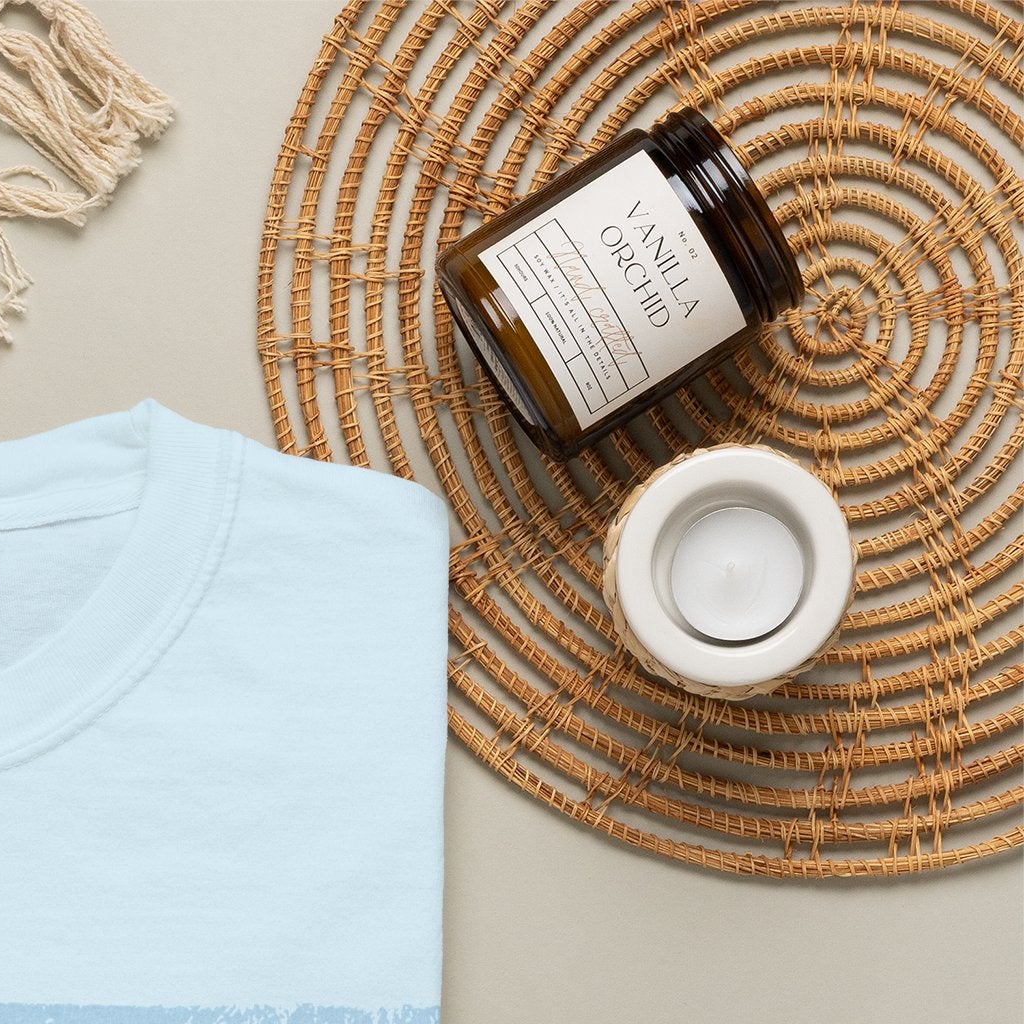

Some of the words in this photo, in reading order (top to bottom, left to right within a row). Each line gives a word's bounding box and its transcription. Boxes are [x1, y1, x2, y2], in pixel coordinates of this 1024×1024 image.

[601, 226, 670, 327] ORCHID
[627, 200, 700, 318] VANILLA
[688, 248, 698, 259] 02
[534, 254, 545, 267] SOY
[543, 269, 554, 283] WAX
[558, 291, 570, 306] IT'S
[569, 309, 578, 322] ALL
[578, 324, 586, 333] IN
[585, 336, 596, 350] THE
[594, 352, 611, 380] DETAILS
[553, 323, 567, 344] NATURAL
